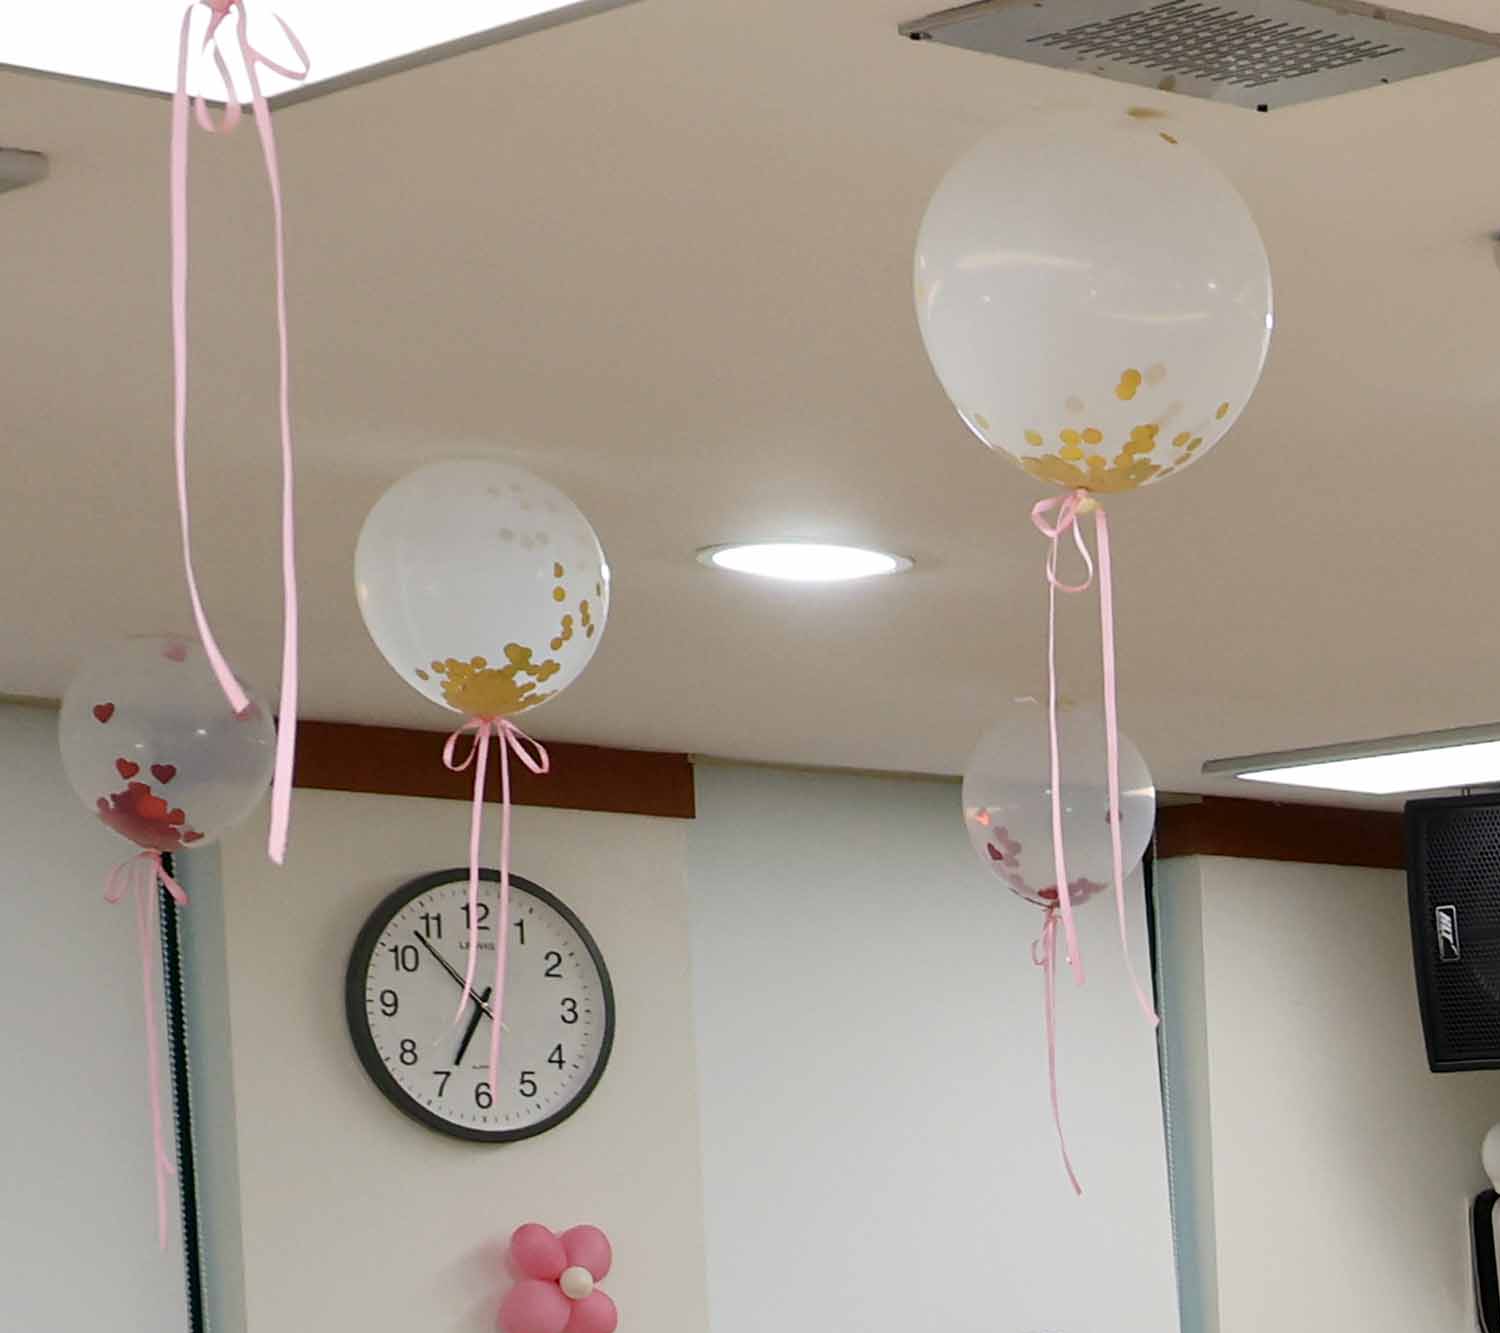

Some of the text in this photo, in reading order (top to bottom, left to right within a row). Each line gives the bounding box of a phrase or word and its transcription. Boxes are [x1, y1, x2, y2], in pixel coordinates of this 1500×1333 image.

[420, 913, 442, 939] 11
[461, 903, 490, 930] 12
[514, 919, 525, 944] 1
[389, 945, 420, 972] 10
[544, 951, 563, 978] 2
[380, 990, 398, 1016] 9
[560, 998, 578, 1024] 3
[400, 1039, 417, 1066] 8
[547, 1044, 566, 1070] 4
[434, 1071, 451, 1097] 7
[475, 1082, 493, 1109] 6
[519, 1072, 537, 1097] 5
